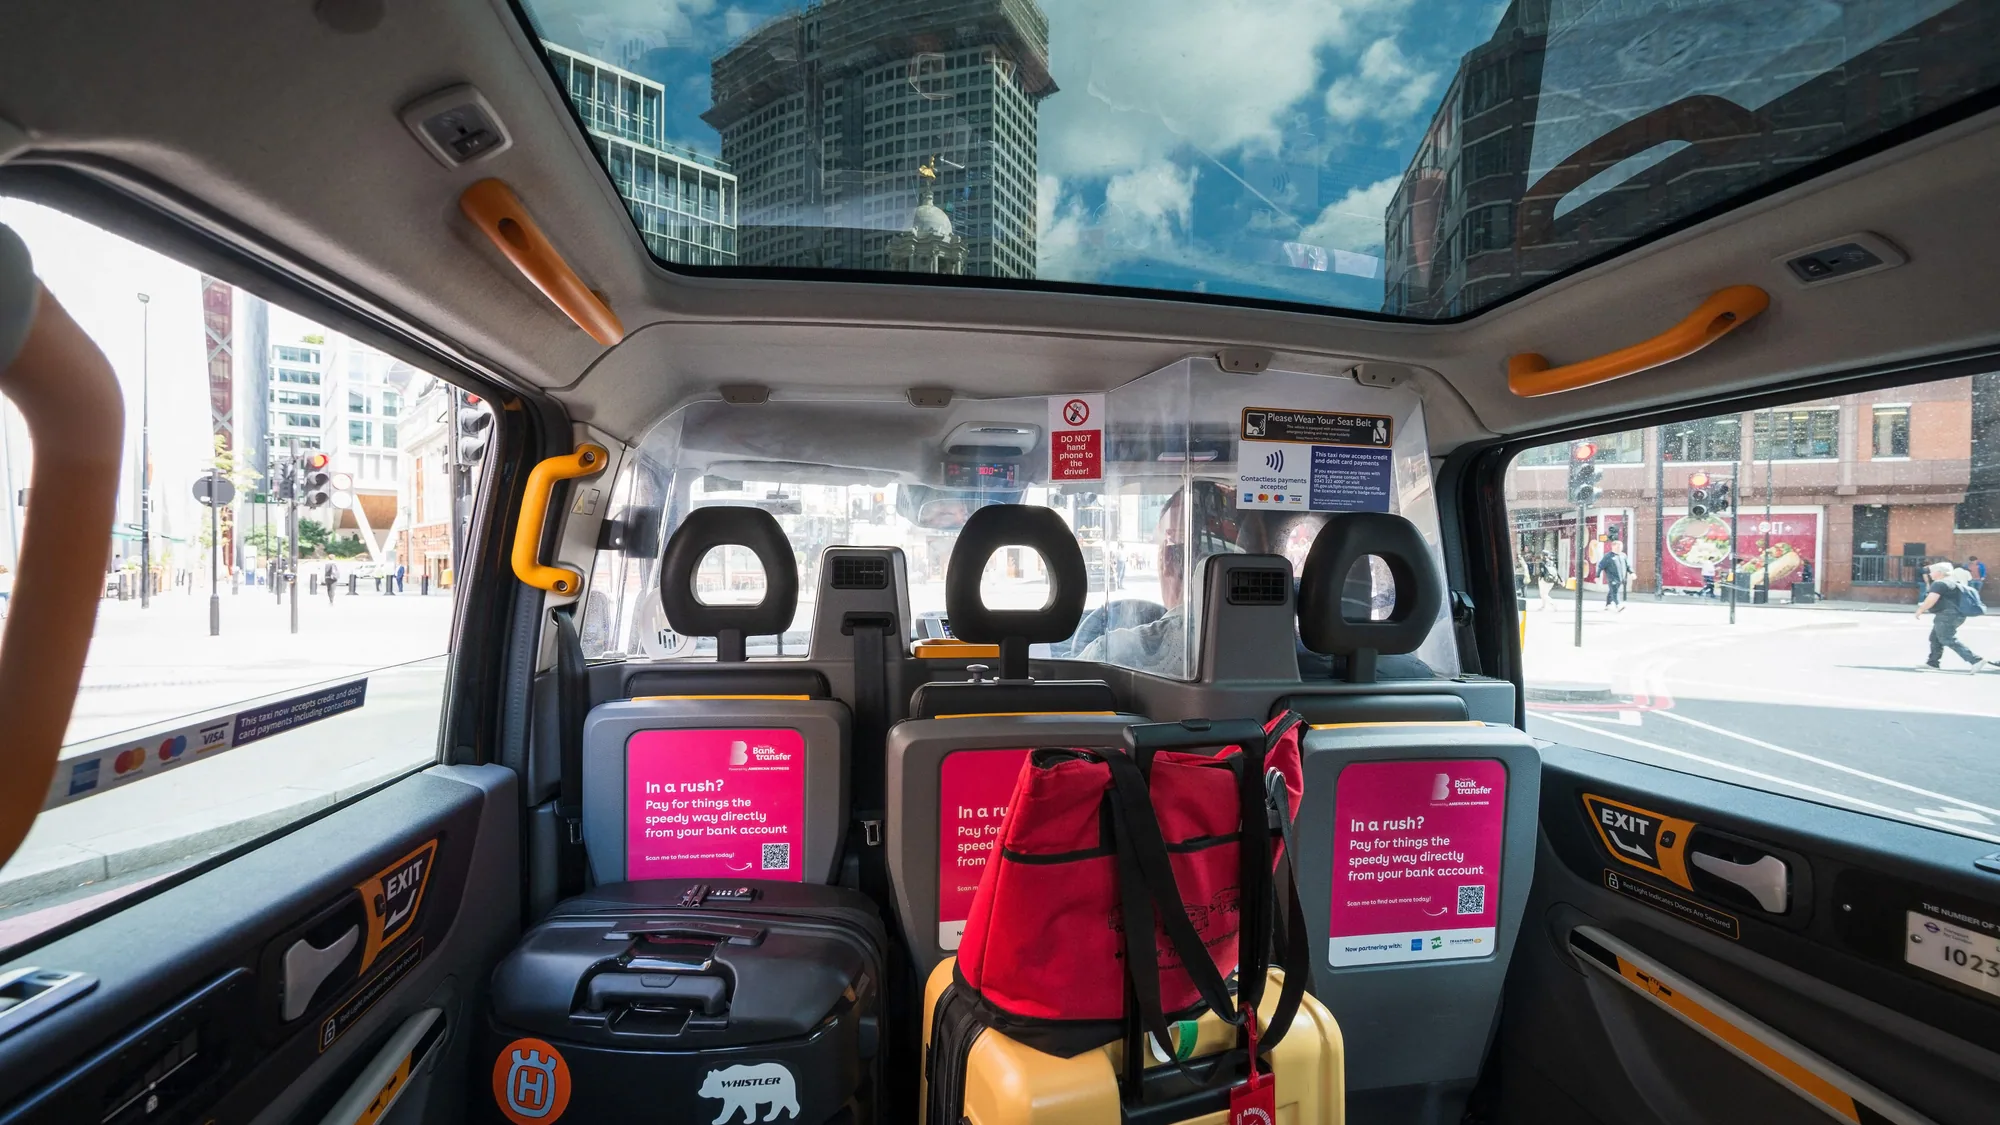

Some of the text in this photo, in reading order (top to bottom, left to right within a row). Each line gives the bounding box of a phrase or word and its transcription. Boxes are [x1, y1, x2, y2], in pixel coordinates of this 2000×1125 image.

[1267, 413, 1372, 428] Please Wear Your Seat Belt
[240, 686, 362, 727] This taxi now accepts credit and debit
[238, 698, 356, 740] card payments including contactless
[203, 730, 224, 745] VISA
[756, 752, 791, 761] transfer
[646, 779, 724, 794] In a rush?
[1455, 780, 1476, 788] Bank
[1457, 786, 1492, 795] transfer
[646, 798, 751, 811] Pay for things the
[646, 811, 767, 825] speedy way directly
[958, 806, 972, 819] In
[977, 807, 988, 818] a
[1351, 816, 1425, 832] In a rush?
[1602, 808, 1649, 835] EXIT
[645, 824, 788, 839] from your bank account
[958, 824, 1002, 838] Pay for
[958, 840, 994, 853] speed
[1350, 836, 1450, 852] Pay for things the
[957, 856, 986, 866] from
[1349, 851, 1464, 868] speedy way directly
[386, 859, 423, 901] EXIT
[1348, 865, 1484, 882] from your bank account
[1623, 882, 1730, 929] Red Light Indicates Doors Are Secured
[1922, 902, 1939, 913] THE
[1941, 908, 1980, 925] NUMBER
[1358, 944, 1387, 952] partnering
[518, 1070, 544, 1104] H
[721, 1076, 781, 1087] WHISTLER
